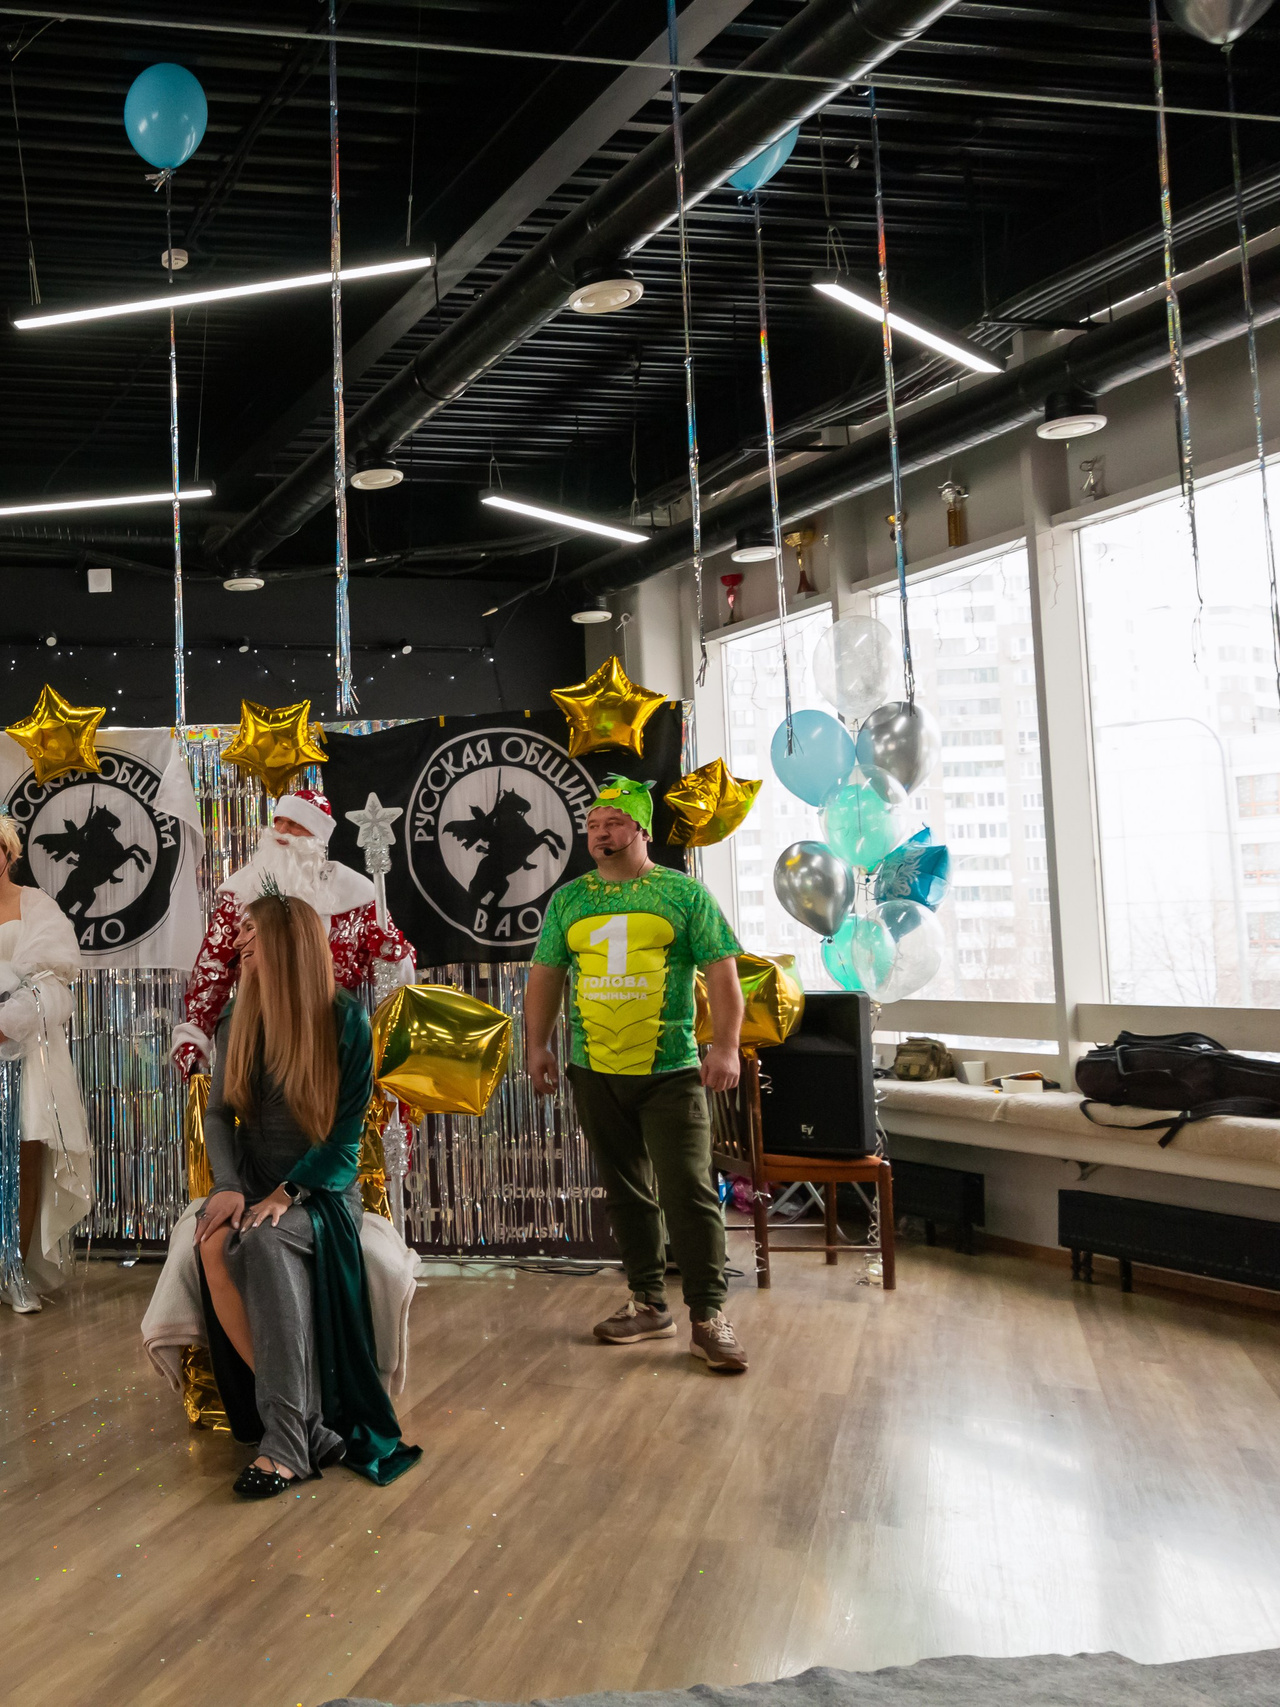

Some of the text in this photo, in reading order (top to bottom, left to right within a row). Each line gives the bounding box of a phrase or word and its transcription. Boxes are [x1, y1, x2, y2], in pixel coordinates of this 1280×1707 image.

[97, 756, 176, 848] ОБЩНА
[414, 736, 592, 842] РУССКАЯ ОБЩИНА
[72, 918, 125, 946] АО
[473, 906, 542, 937] ВАО
[590, 915, 628, 975] 1
[583, 976, 648, 988] ГОЛОВА
[583, 991, 648, 1000] ГОРЫНЫЧА
